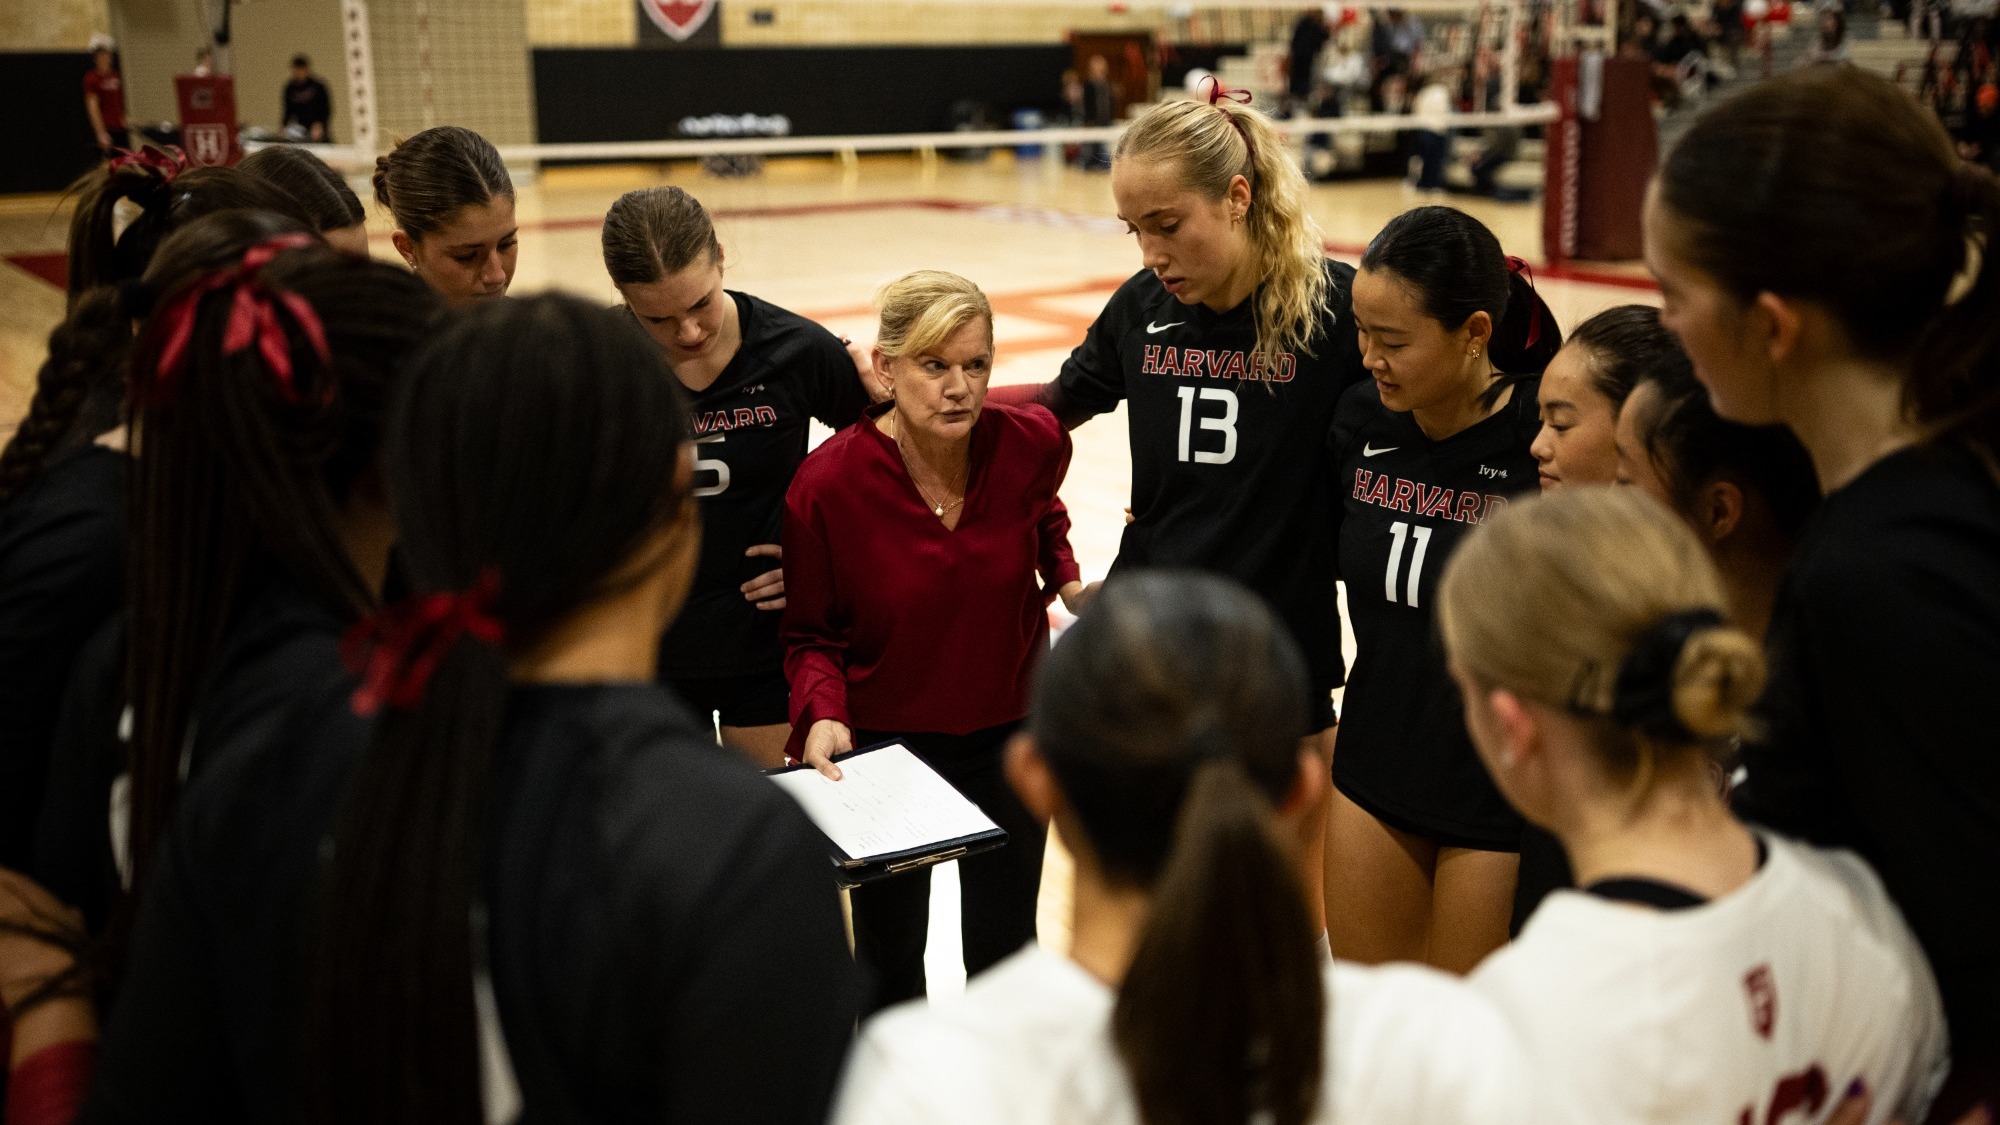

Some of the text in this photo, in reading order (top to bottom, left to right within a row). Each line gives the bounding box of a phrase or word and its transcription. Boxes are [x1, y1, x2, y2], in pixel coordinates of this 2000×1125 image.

[1142, 344, 1296, 383] HARVARD
[691, 405, 777, 434] VARD
[1177, 385, 1239, 465] 13
[1478, 464, 1499, 479] Ivy
[1352, 467, 1508, 525] HARVARD
[1384, 521, 1433, 609] 11
